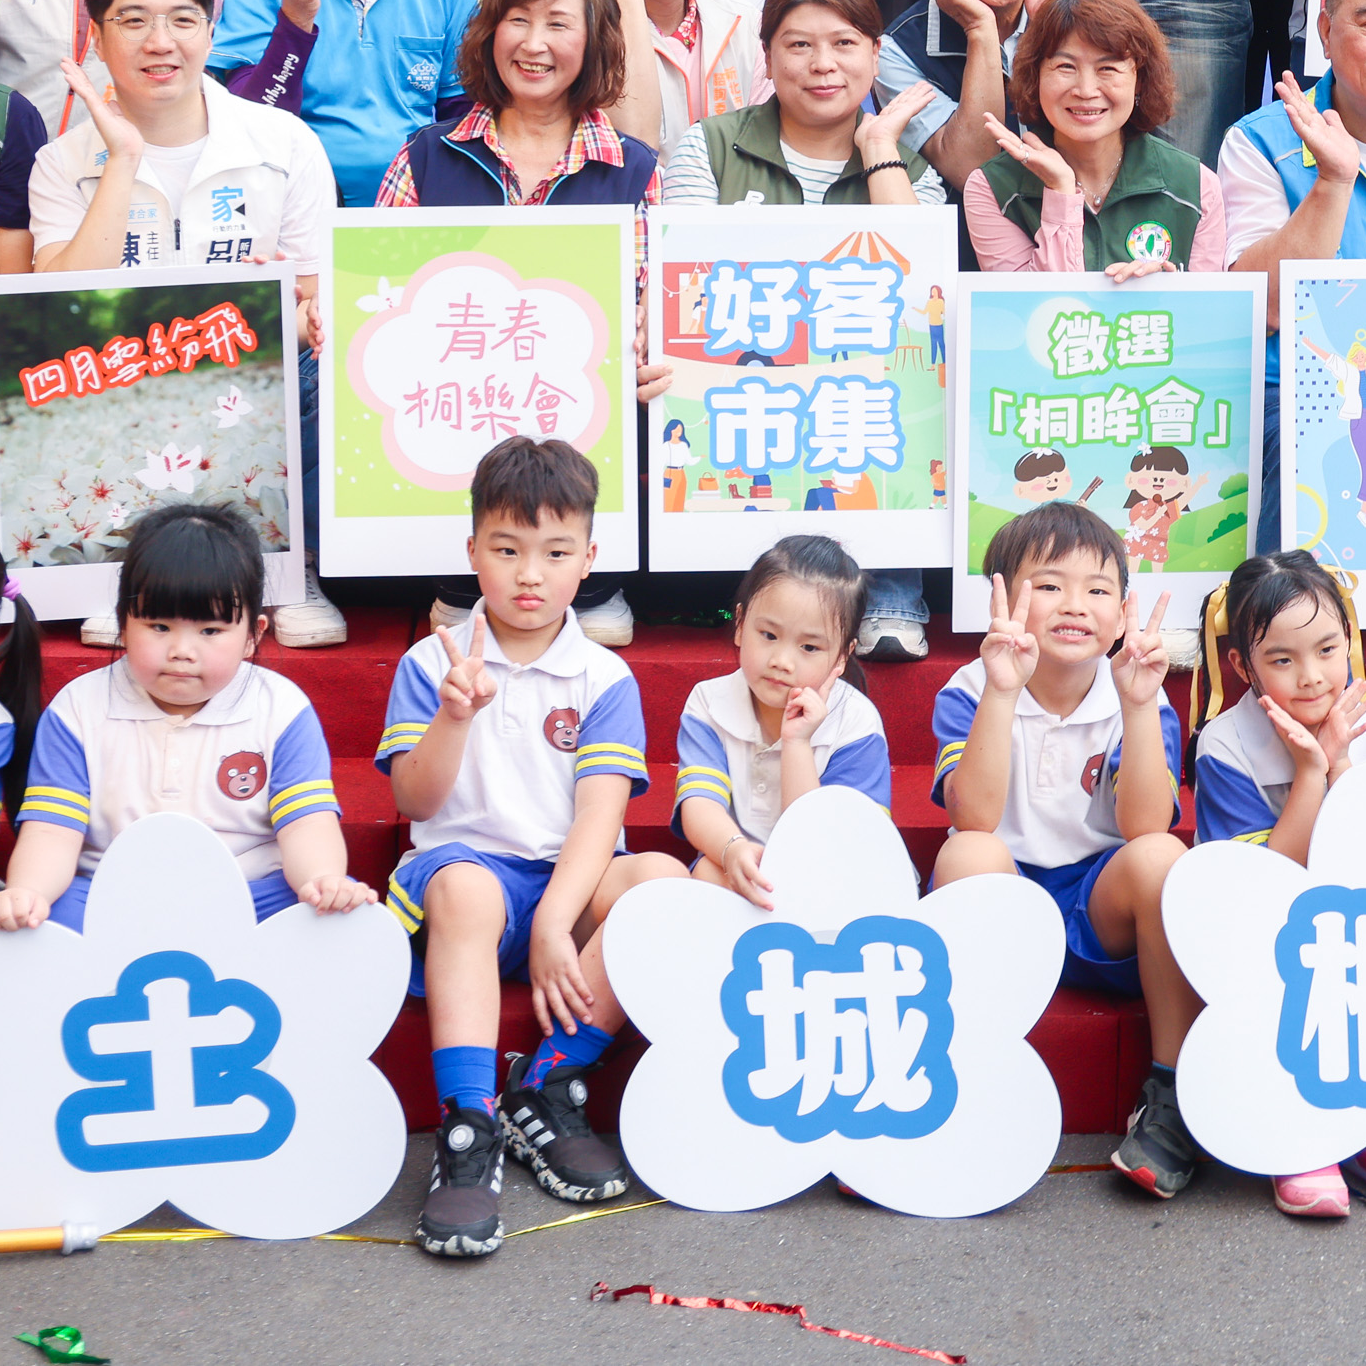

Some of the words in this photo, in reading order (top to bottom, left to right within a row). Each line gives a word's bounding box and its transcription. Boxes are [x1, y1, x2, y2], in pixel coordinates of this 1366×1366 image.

[211, 186, 244, 222] 家
[146, 231, 160, 261] 主任
[206, 239, 235, 264] 呂
[436, 293, 546, 363] 青春
[707, 260, 902, 353] 好客
[22, 304, 256, 405] 四月雪紛飛
[1049, 312, 1172, 378] 徵選
[403, 372, 578, 440] 桐樂會
[707, 378, 902, 472] 市集
[990, 377, 1231, 447] 「桐眸會」
[71, 964, 275, 1160] 土
[734, 929, 945, 1126] 城
